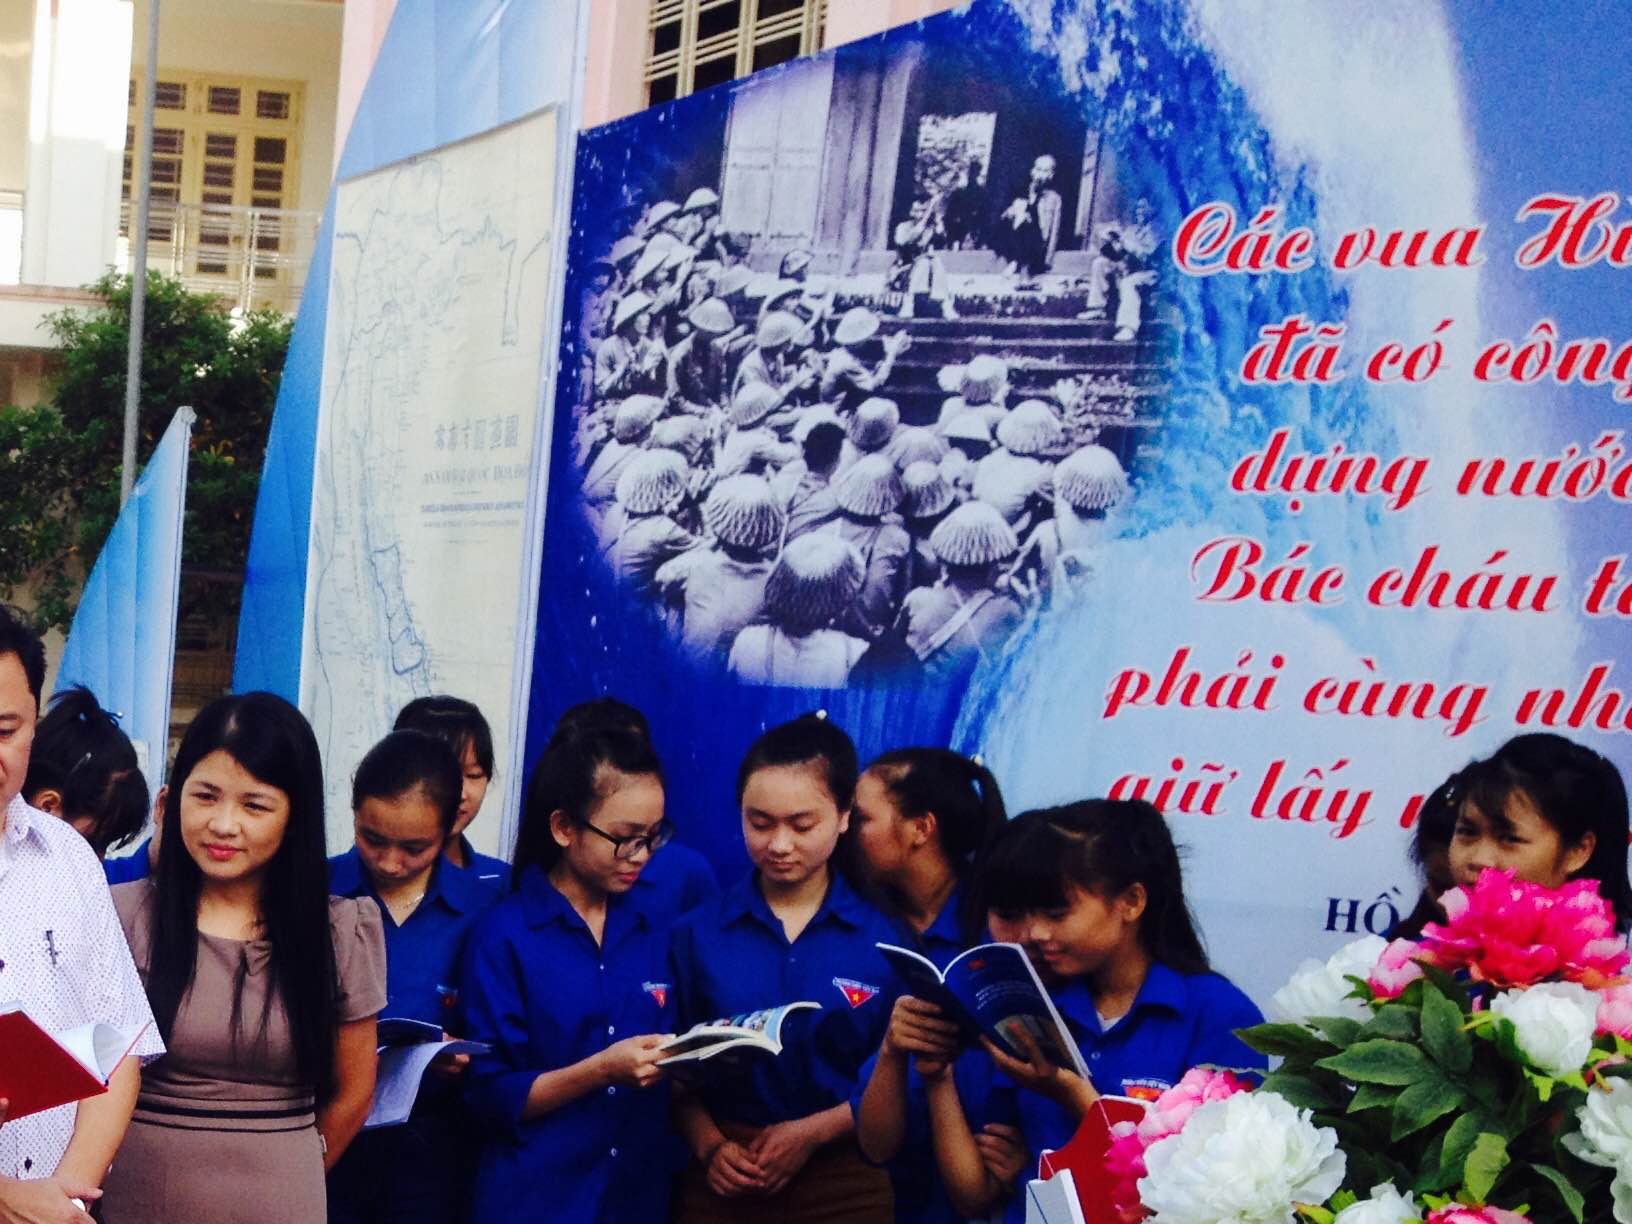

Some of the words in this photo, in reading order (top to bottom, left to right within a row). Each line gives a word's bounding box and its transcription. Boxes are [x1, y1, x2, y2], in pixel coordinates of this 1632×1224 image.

[1174, 204, 1310, 272] Các
[1333, 228, 1482, 270] vua
[1242, 318, 1341, 383] đã
[1366, 319, 1454, 383] có
[1231, 431, 1430, 512] dựng
[1193, 540, 1344, 604] Bác
[1367, 544, 1560, 613] cháu
[1302, 658, 1490, 737] cùng
[1514, 664, 1632, 732] nh
[1250, 759, 1375, 840] lấy
[1325, 886, 1402, 937] HỒ
